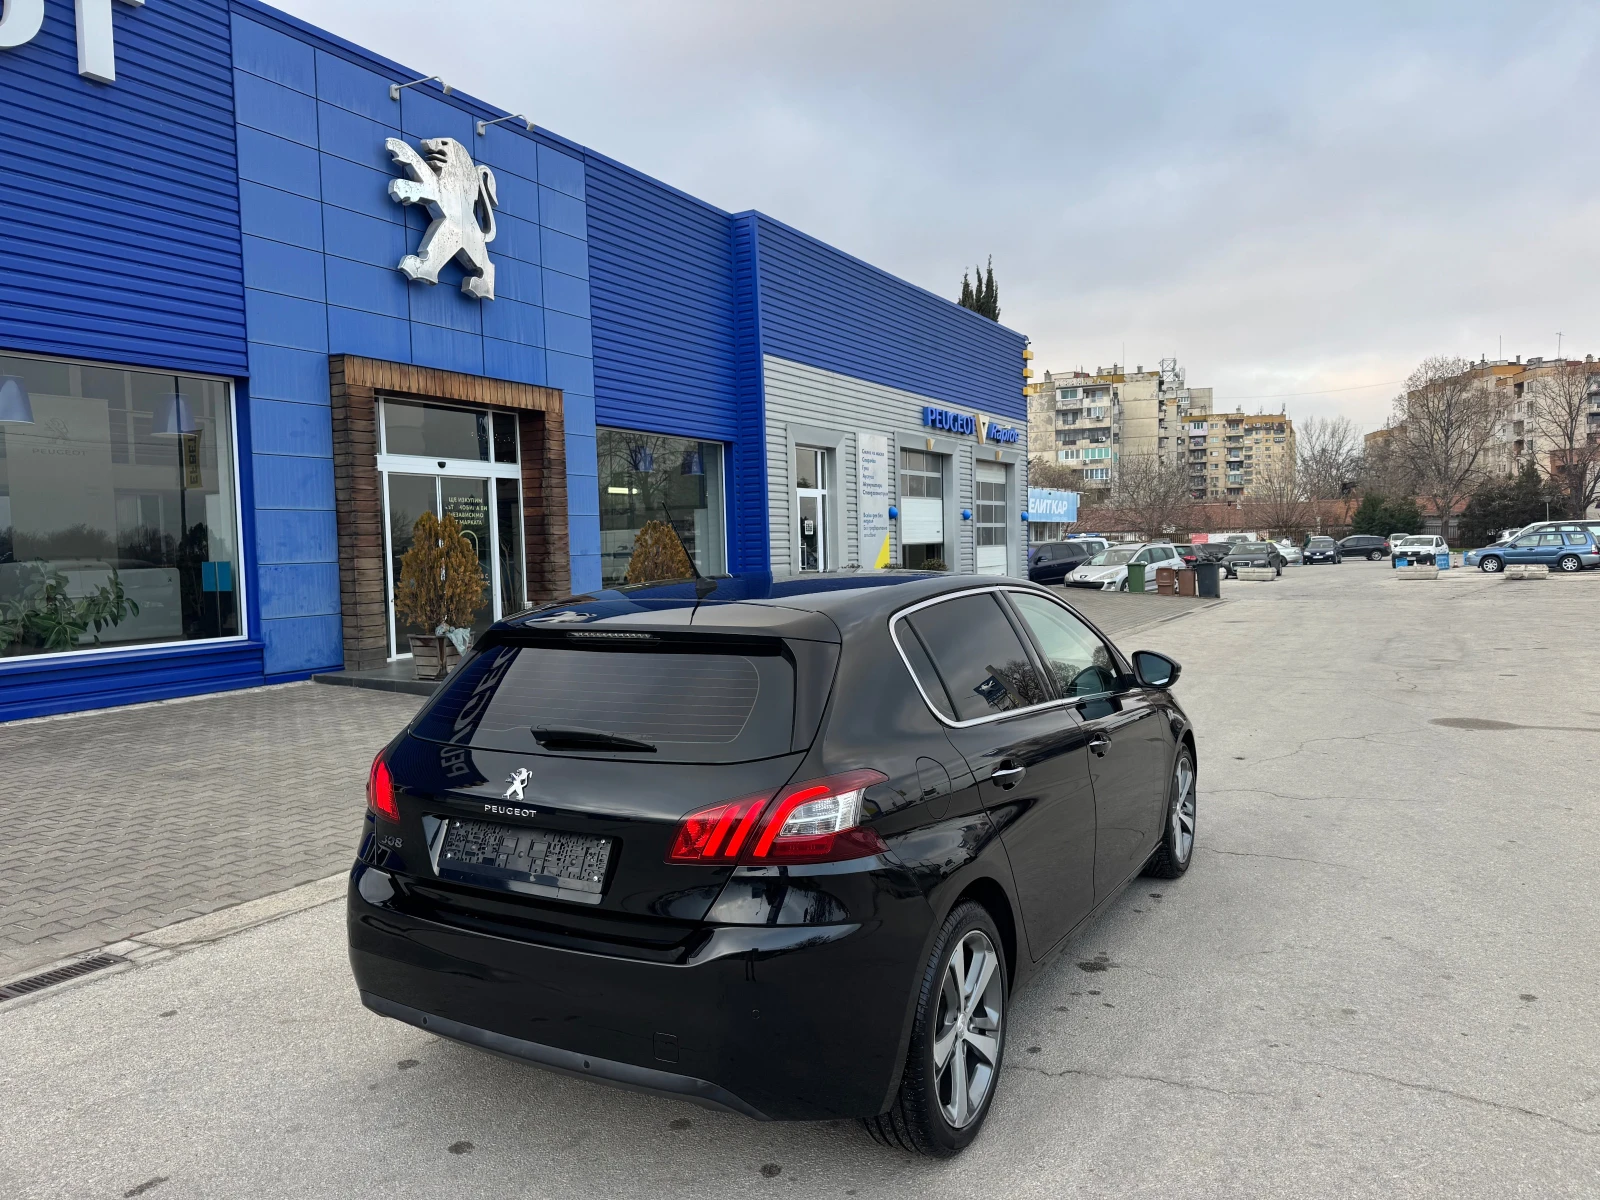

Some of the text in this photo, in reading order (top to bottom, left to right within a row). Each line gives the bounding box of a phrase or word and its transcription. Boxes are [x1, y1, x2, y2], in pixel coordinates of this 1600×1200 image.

[923, 407, 976, 435] PEUGEOT
[32, 447, 88, 457] PEUGEOT
[483, 804, 537, 818] PEUGEOT
